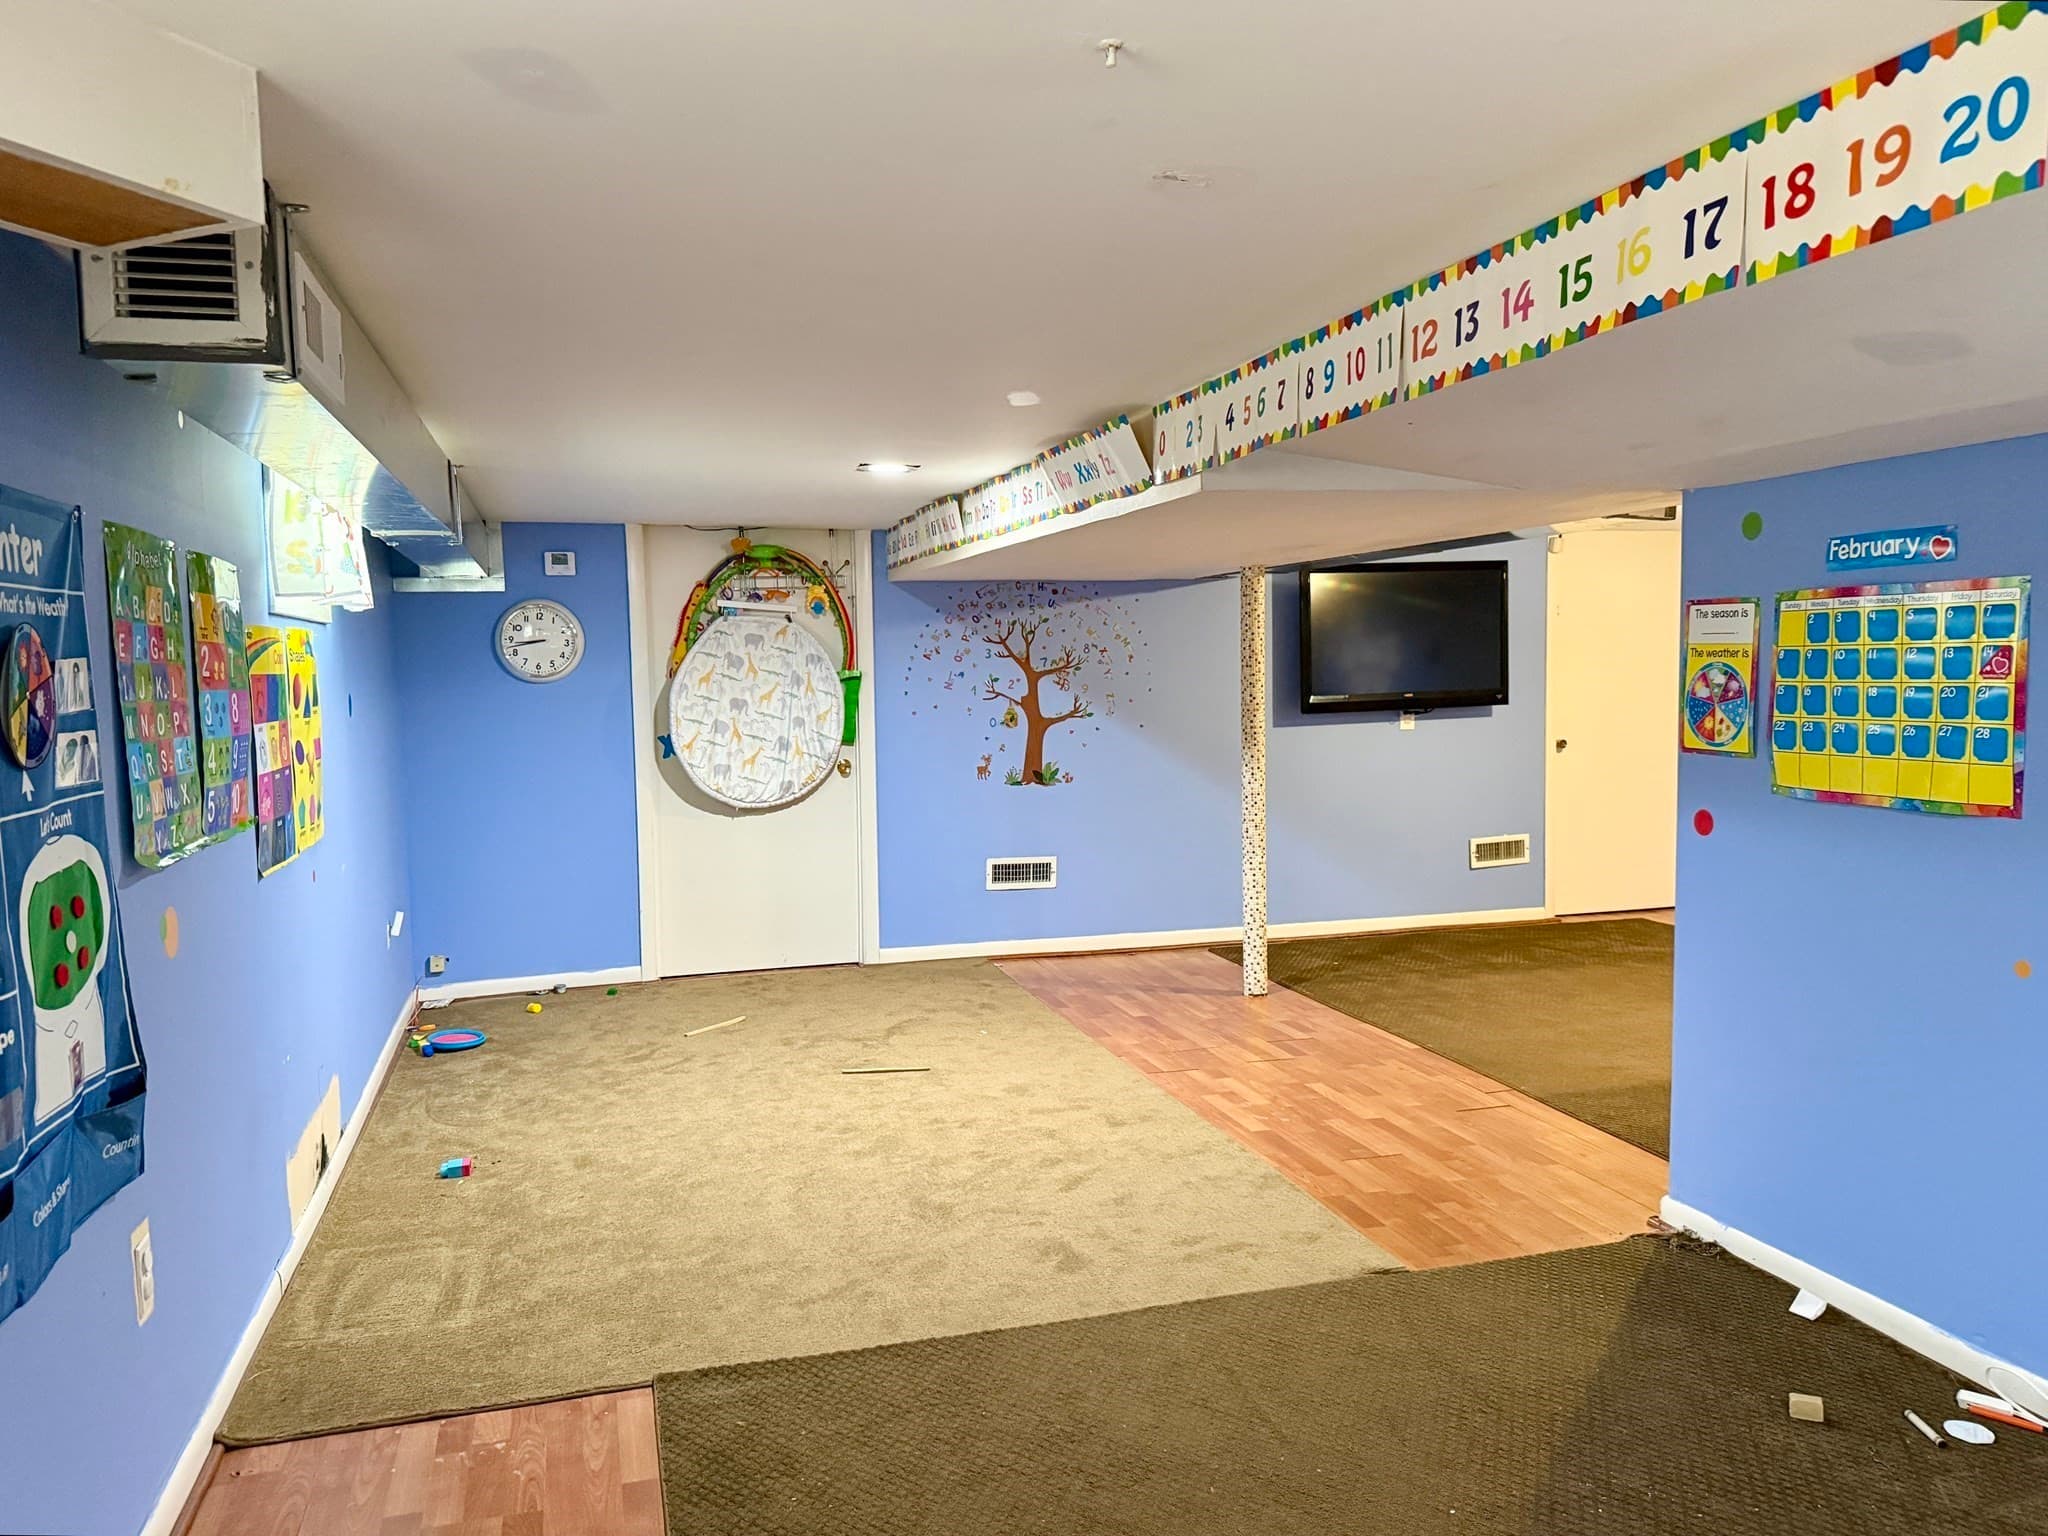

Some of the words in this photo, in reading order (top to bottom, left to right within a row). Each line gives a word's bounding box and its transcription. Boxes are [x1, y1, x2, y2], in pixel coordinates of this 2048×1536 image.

[1761, 162, 1815, 230] 18
[1846, 123, 1912, 197] 19
[1939, 75, 2030, 164] 20
[1411, 319, 1438, 363] 12
[1454, 300, 1480, 348] 13
[1501, 279, 1535, 329] 14
[1559, 254, 1592, 309] 15
[1617, 226, 1651, 286] 16
[1683, 195, 1729, 260] 17
[1306, 366, 1314, 400] 8
[1324, 359, 1335, 394] 9
[1347, 346, 1365, 385] 10
[1377, 332, 1392, 374] 11
[1225, 402, 1234, 432] 4
[1244, 395, 1251, 425] 5
[1257, 386, 1266, 417] 6
[1278, 379, 1286, 411] 7
[1159, 431, 1166, 456] 0
[1186, 420, 1193, 448] 2
[1198, 415, 1203, 443] 3
[1074, 462, 1093, 484] Xx
[1022, 486, 1032, 505] Ss
[1035, 481, 1043, 501] Tt
[127, 540, 162, 569] Alphabet
[1829, 537, 1921, 561] February
[1984, 591, 2017, 600] Saturday
[116, 600, 124, 617] A
[132, 596, 140, 619] B
[164, 600, 170, 624] D
[196, 597, 204, 628] 1
[536, 612, 544, 620] 12
[1029, 605, 1036, 616] 5
[1696, 608, 1708, 619] The
[1710, 609, 1740, 618] season
[1741, 607, 1749, 618] is
[1808, 614, 1814, 624] 2
[1836, 614, 1842, 622] 3
[1869, 612, 1876, 621] 4
[1907, 610, 1914, 620] 5
[1946, 607, 1954, 618] 6
[1986, 606, 1992, 616] 7
[512, 624, 522, 632] 10
[994, 618, 1002, 629] 4
[1046, 626, 1054, 637] 6
[118, 634, 126, 658] E
[136, 636, 142, 658] F
[150, 636, 158, 660] G
[166, 638, 175, 660] H
[512, 648, 518, 656] 8
[984, 648, 992, 659] 3
[1083, 643, 1090, 654] 8
[1690, 648, 1704, 658] The
[1706, 648, 1740, 658] weather
[1742, 648, 1750, 658] is
[1778, 650, 1784, 659] 8
[1806, 650, 1812, 659] 9
[1834, 650, 1846, 660] 10
[1868, 650, 1877, 659] 11
[1906, 648, 1917, 658] 12
[1944, 648, 1954, 658] 13
[1983, 646, 1993, 656] 14
[201, 644, 210, 678] 2
[228, 647, 234, 678] 7
[522, 658, 528, 666] 7
[536, 662, 542, 670] 6
[550, 660, 555, 668] 5
[1040, 657, 1048, 668] 7
[140, 676, 145, 700] J
[156, 676, 163, 700] K
[172, 676, 178, 698] L
[1008, 680, 1014, 689] 2
[1777, 686, 1784, 695] 15
[1804, 686, 1812, 696] 16
[1834, 687, 1842, 696] 17
[1868, 687, 1878, 696] 18
[1906, 687, 1915, 697] 19
[1940, 687, 1956, 697] 20
[1978, 687, 1989, 698] 21
[204, 693, 212, 726] 3
[232, 692, 239, 723] 8
[126, 715, 135, 739] M
[140, 714, 148, 738] N
[157, 712, 165, 736] O
[173, 712, 180, 734] P
[1774, 722, 1786, 730] 22
[1802, 722, 1814, 732] 23
[1833, 724, 1846, 734] 24
[1867, 725, 1880, 734] 25
[1904, 726, 1916, 736] 26
[1939, 726, 1952, 736] 27
[1976, 728, 1990, 738] 28
[131, 755, 141, 780] Q
[146, 752, 155, 776] R
[160, 750, 168, 773] S
[176, 748, 183, 770] T
[208, 742, 216, 775] 4
[232, 739, 238, 770] 9
[136, 794, 143, 820] U
[152, 792, 160, 814] V
[164, 786, 172, 810] W
[180, 783, 190, 806] X
[208, 790, 215, 823] 5
[232, 784, 240, 814] 10
[49, 809, 72, 831] Count
[156, 831, 162, 854] Y
[170, 824, 179, 848] Z
